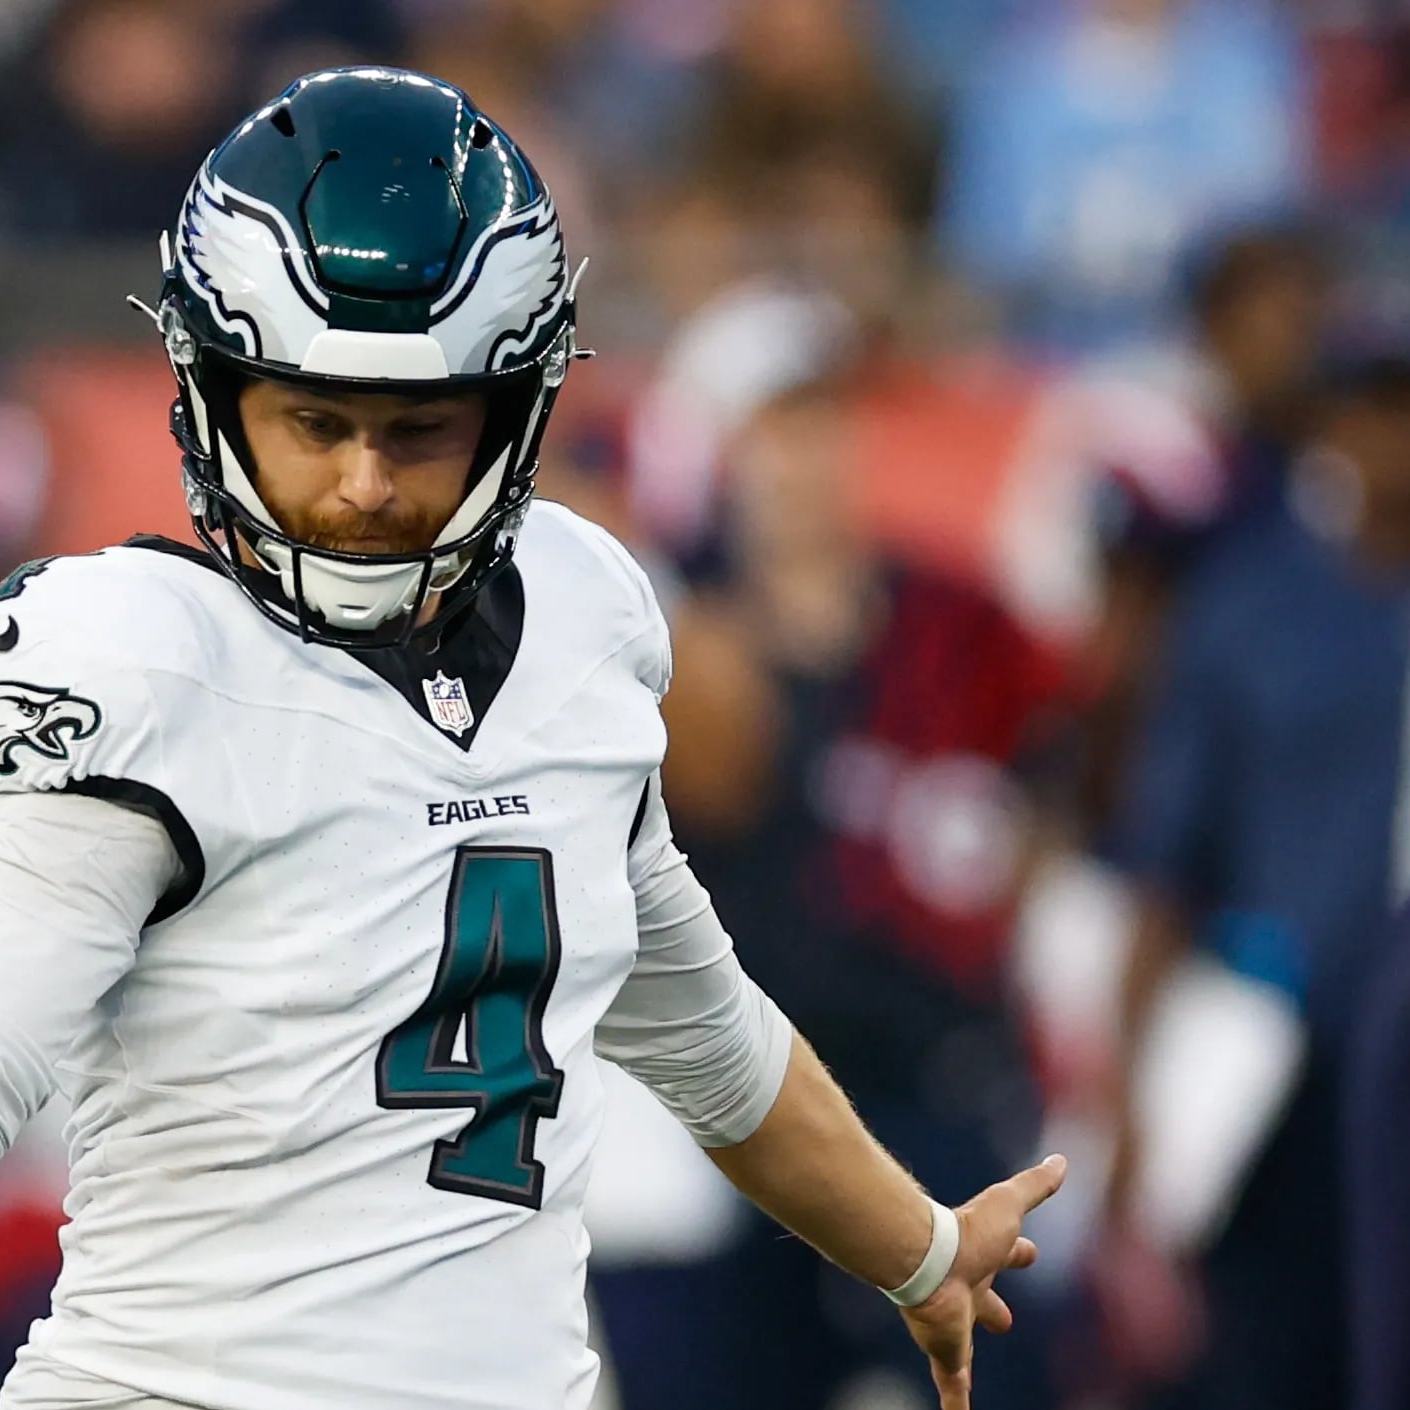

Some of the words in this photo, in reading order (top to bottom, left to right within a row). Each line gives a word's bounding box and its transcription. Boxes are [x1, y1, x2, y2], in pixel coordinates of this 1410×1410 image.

[436, 700, 466, 723] NFL
[426, 795, 530, 826] EAGLES
[375, 845, 565, 1211] 4
